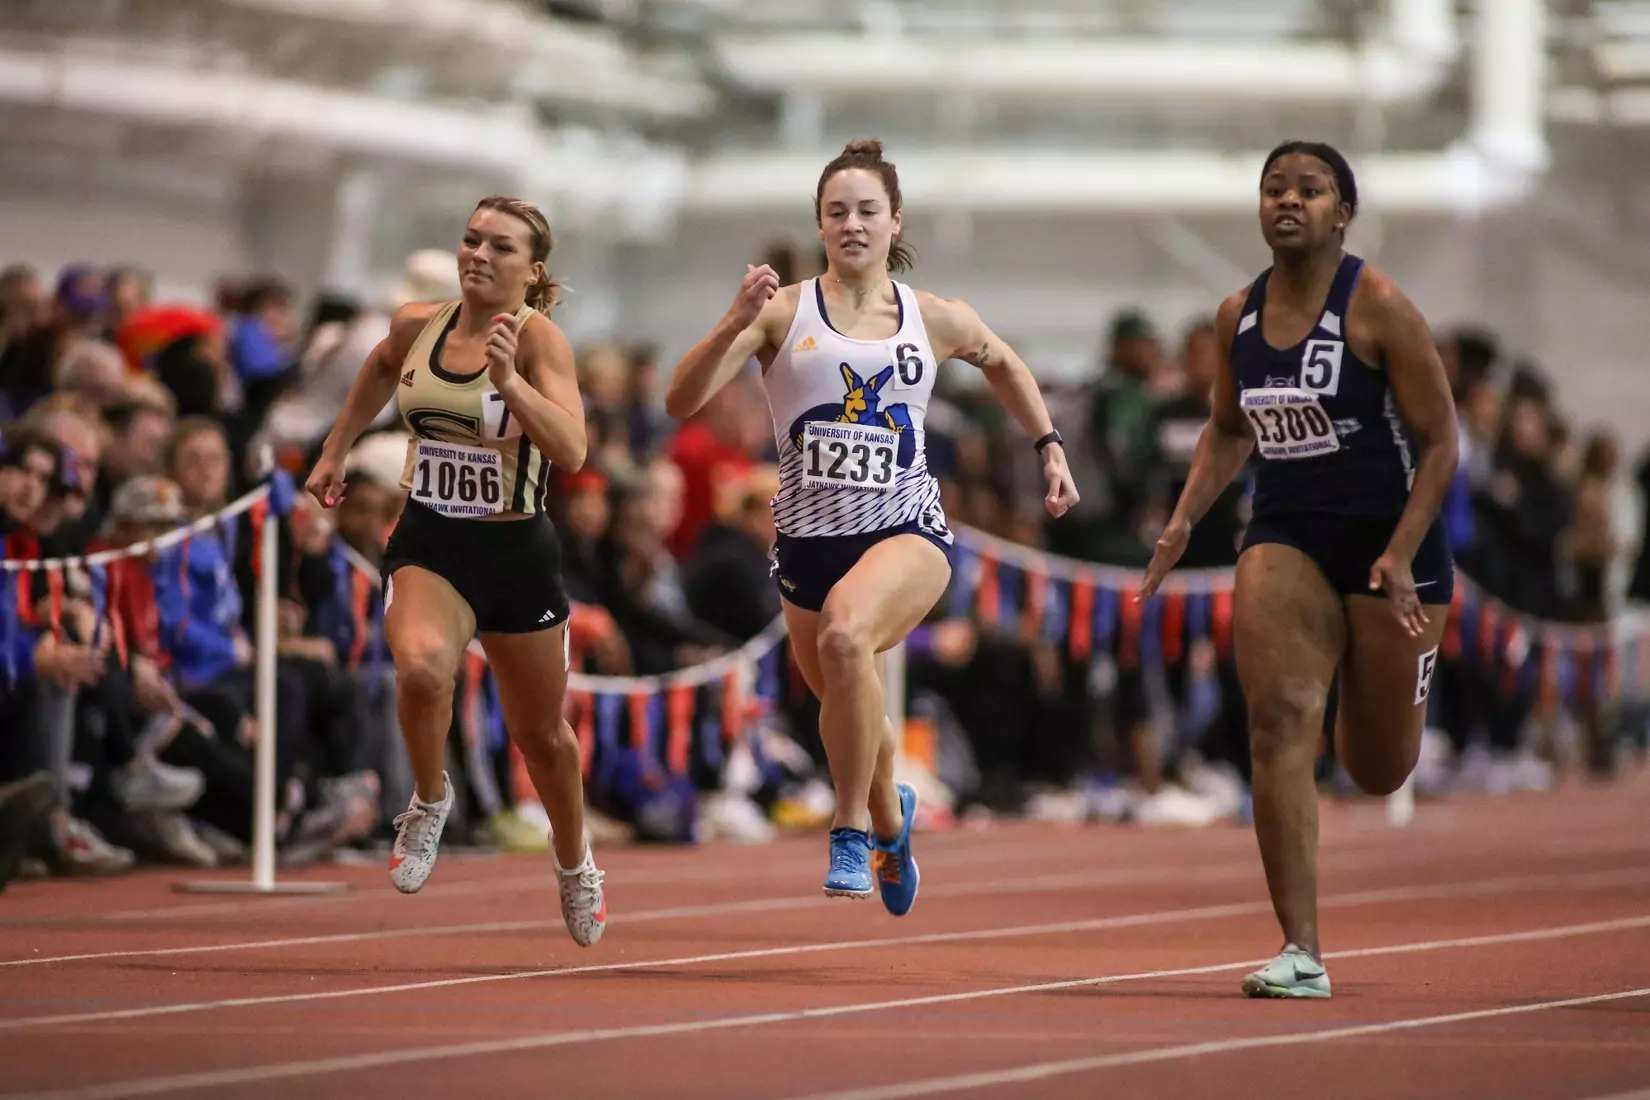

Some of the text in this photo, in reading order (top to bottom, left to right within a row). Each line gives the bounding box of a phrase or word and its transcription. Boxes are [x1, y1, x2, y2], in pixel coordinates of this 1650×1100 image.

[896, 343, 923, 385] 6
[1305, 344, 1335, 389] 5
[490, 393, 511, 437] 7
[809, 425, 895, 445] UNIVERSITY OF KANSAS
[1250, 406, 1329, 443] 1300
[419, 445, 497, 465] UNIVERSITY OF KANSAS
[807, 439, 893, 484] 1233
[416, 459, 500, 504] 1066
[807, 480, 840, 490] JAYHAWK
[1420, 652, 1436, 698] 5
